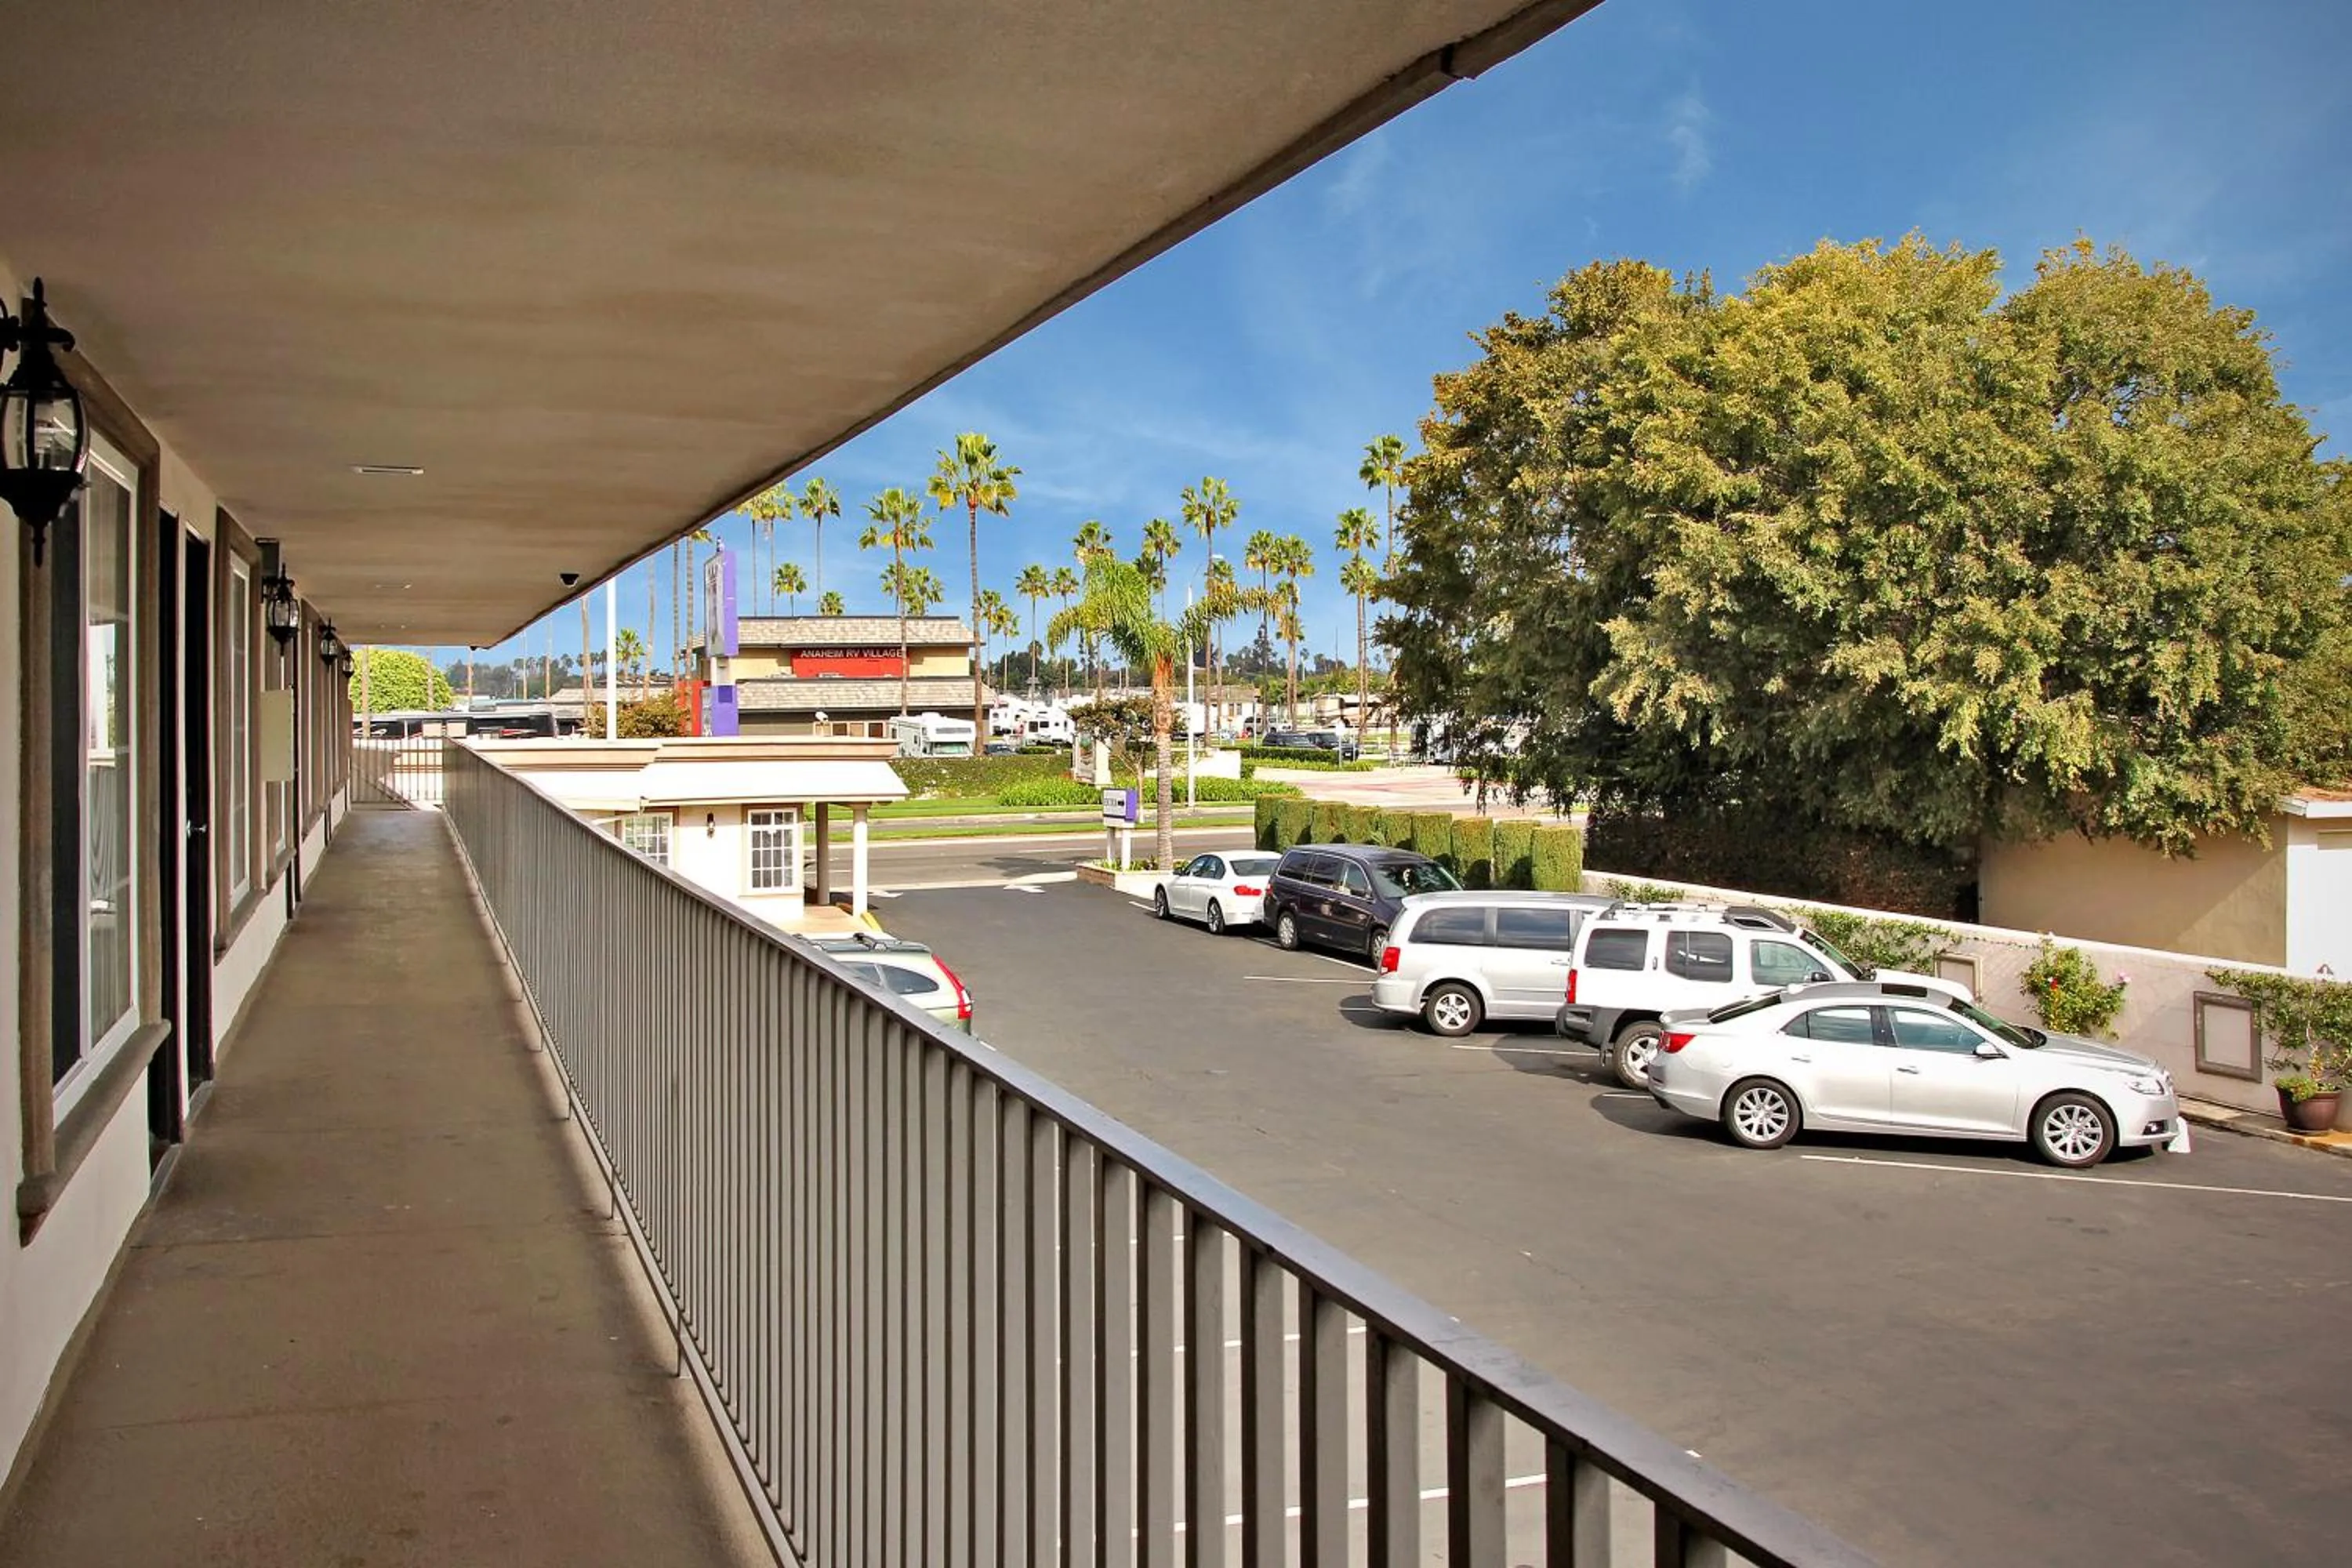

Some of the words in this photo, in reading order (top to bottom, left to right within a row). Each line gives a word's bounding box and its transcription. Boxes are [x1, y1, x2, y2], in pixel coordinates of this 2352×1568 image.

[800, 649, 844, 658] ANAHEIM
[846, 649, 860, 658] RV
[862, 648, 902, 658] VILLAGE
